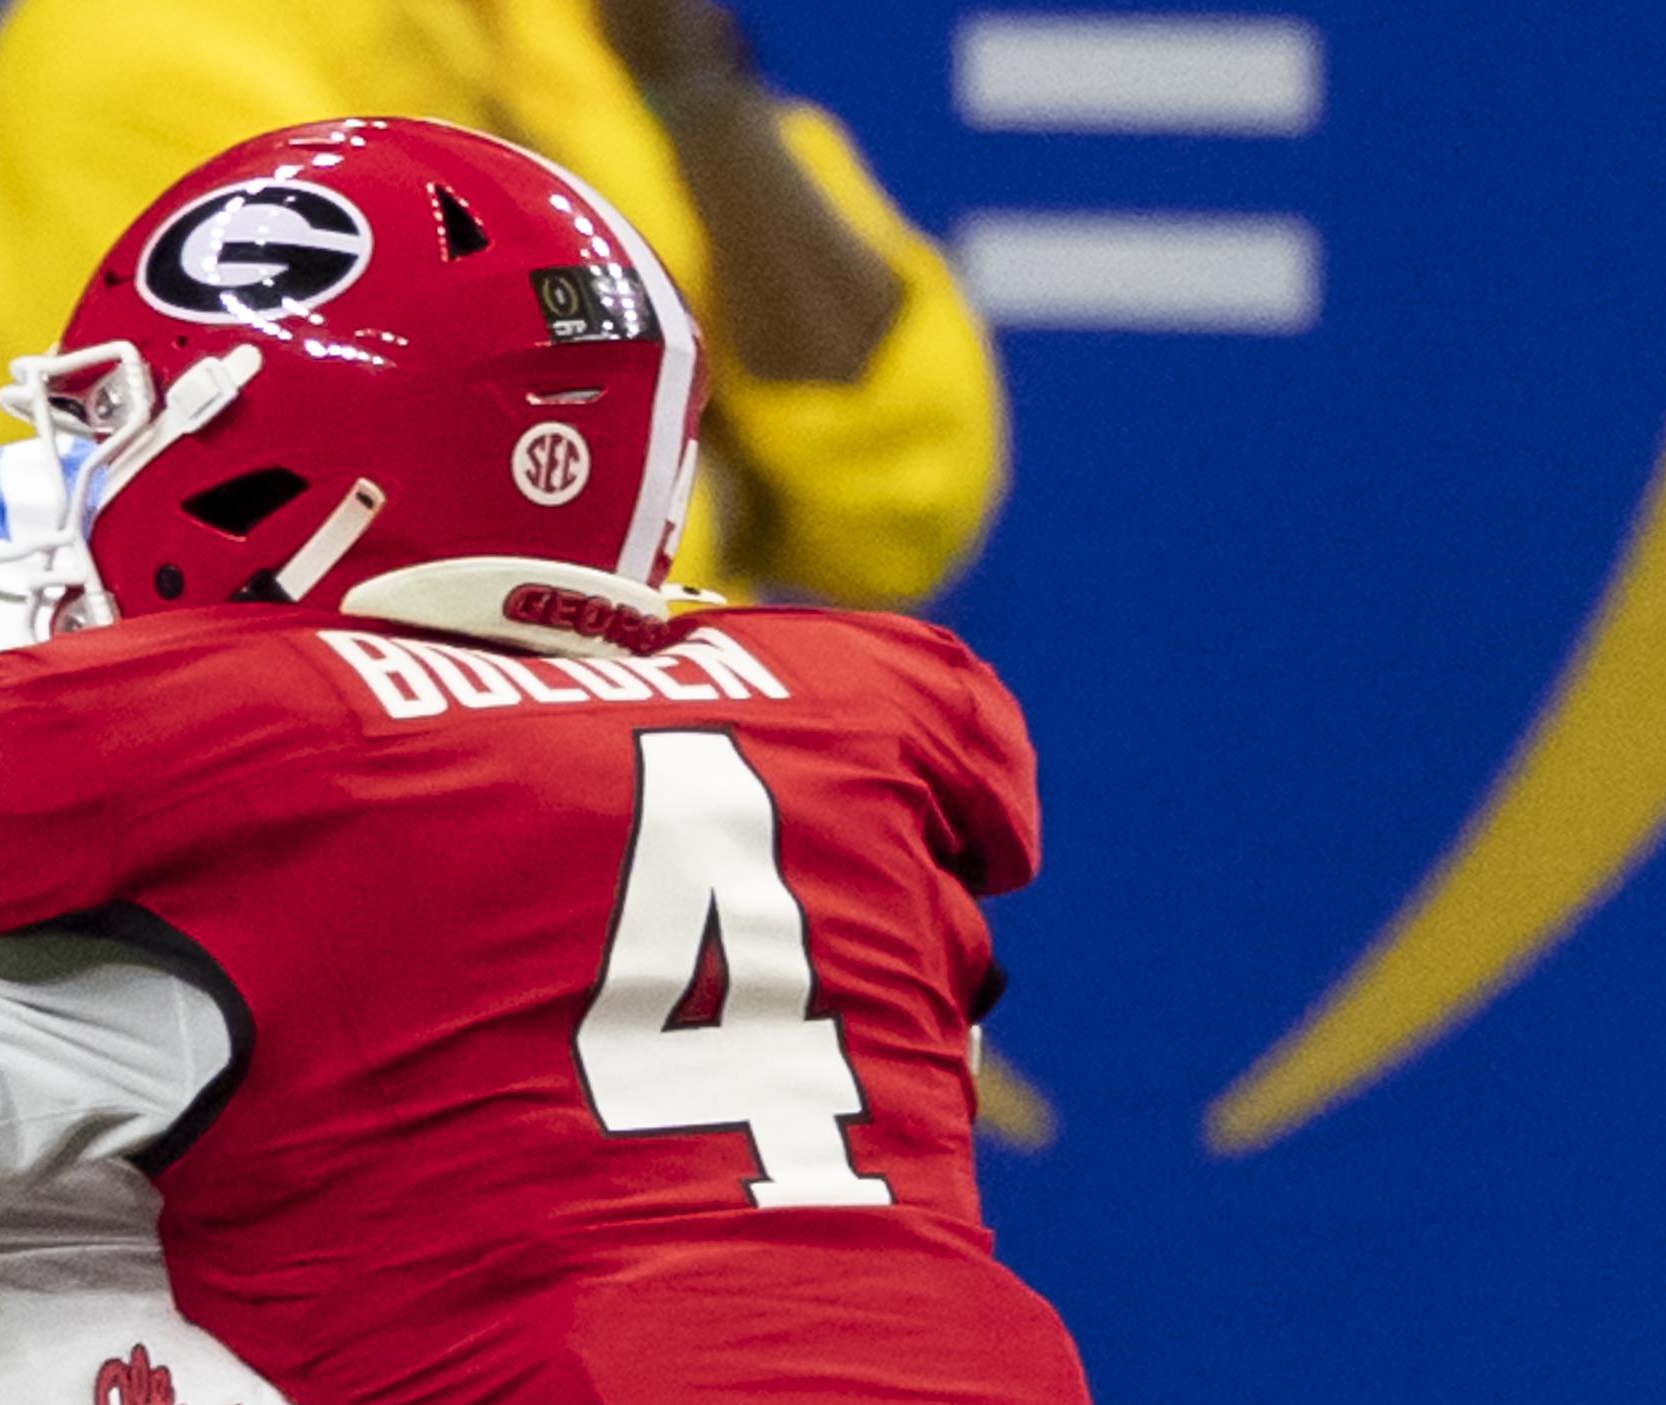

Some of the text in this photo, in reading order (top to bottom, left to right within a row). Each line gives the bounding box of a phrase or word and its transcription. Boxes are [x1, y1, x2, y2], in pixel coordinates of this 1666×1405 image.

[179, 196, 371, 290] G
[525, 432, 581, 493] SEC
[316, 626, 791, 720] BOLDEN
[573, 728, 895, 1209] 4
